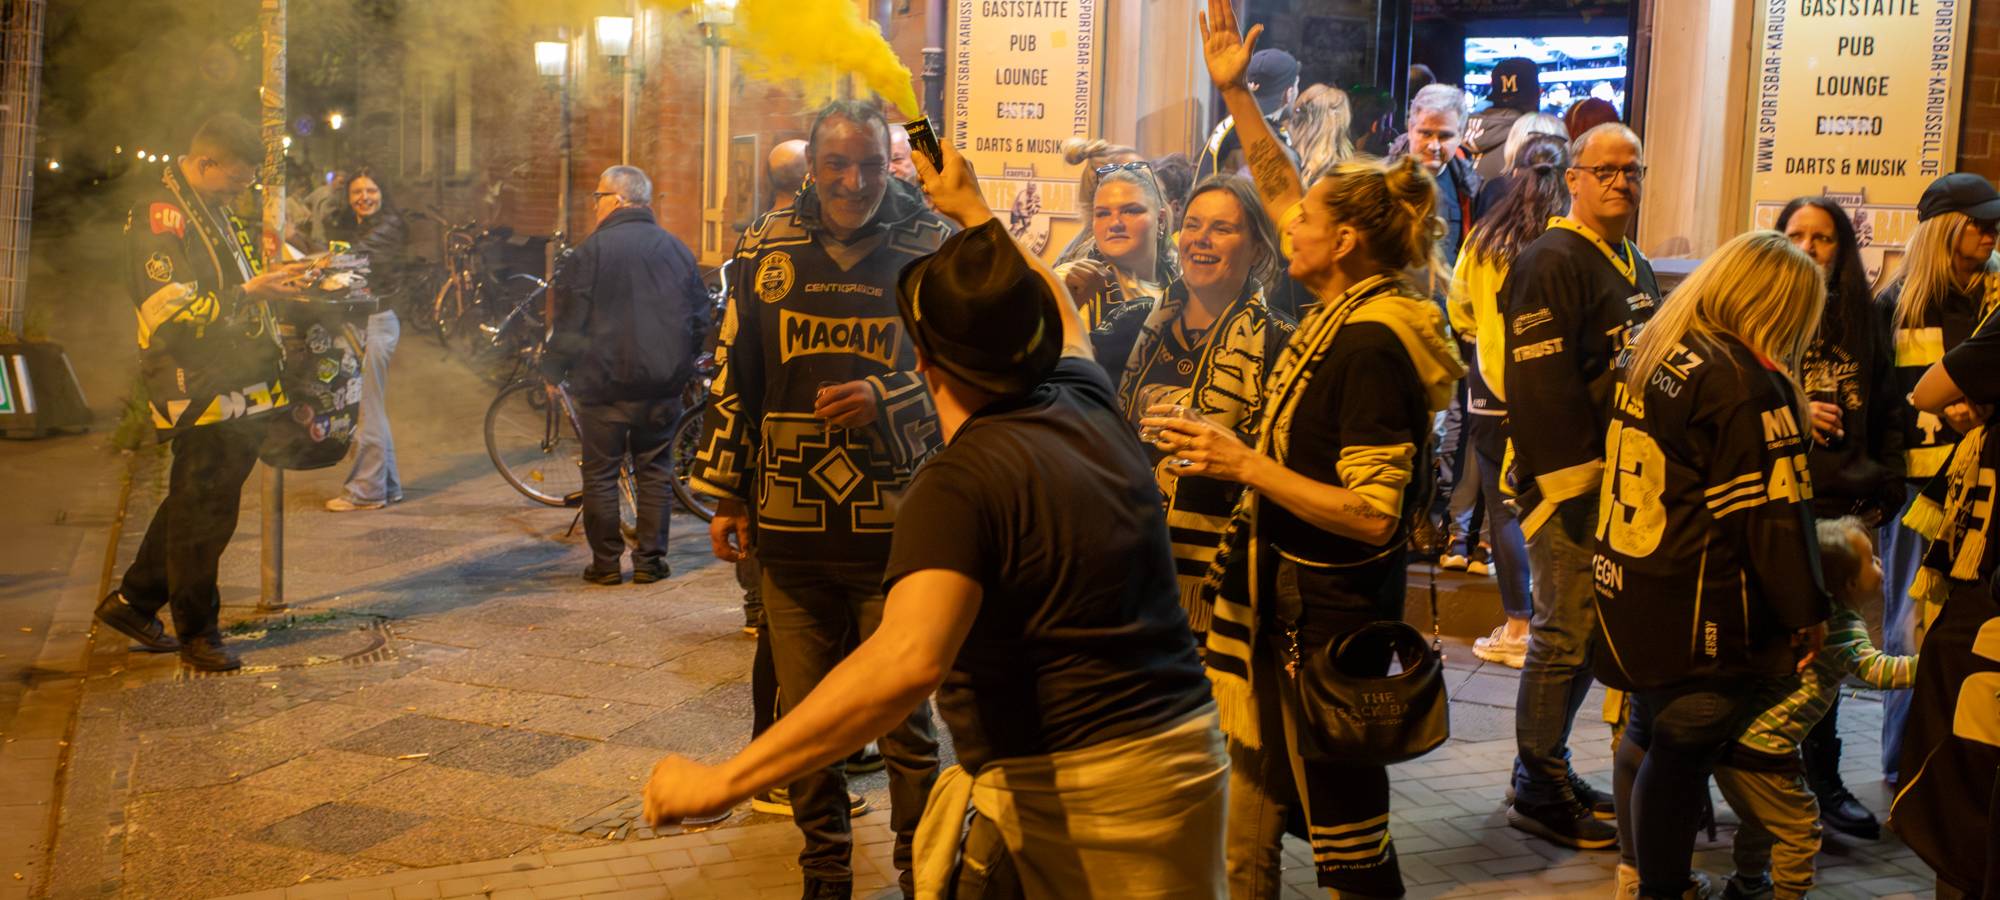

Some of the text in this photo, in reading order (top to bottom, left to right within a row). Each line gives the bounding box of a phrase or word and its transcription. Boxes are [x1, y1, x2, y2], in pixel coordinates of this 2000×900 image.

[1010, 34, 1037, 52] PUB
[1837, 36, 1875, 56] PUB
[996, 68, 1048, 86] LOUNGE
[1501, 74, 1518, 93] M
[1816, 76, 1890, 96] LOUNGE
[997, 102, 1044, 120] BISTRO
[1815, 116, 1883, 136] BISTRO
[976, 137, 1063, 154] DARTS & MUSIK
[1785, 157, 1907, 176] DARTS & MUSIK
[787, 316, 896, 360] MAOAM
[1652, 365, 1683, 398] bau
